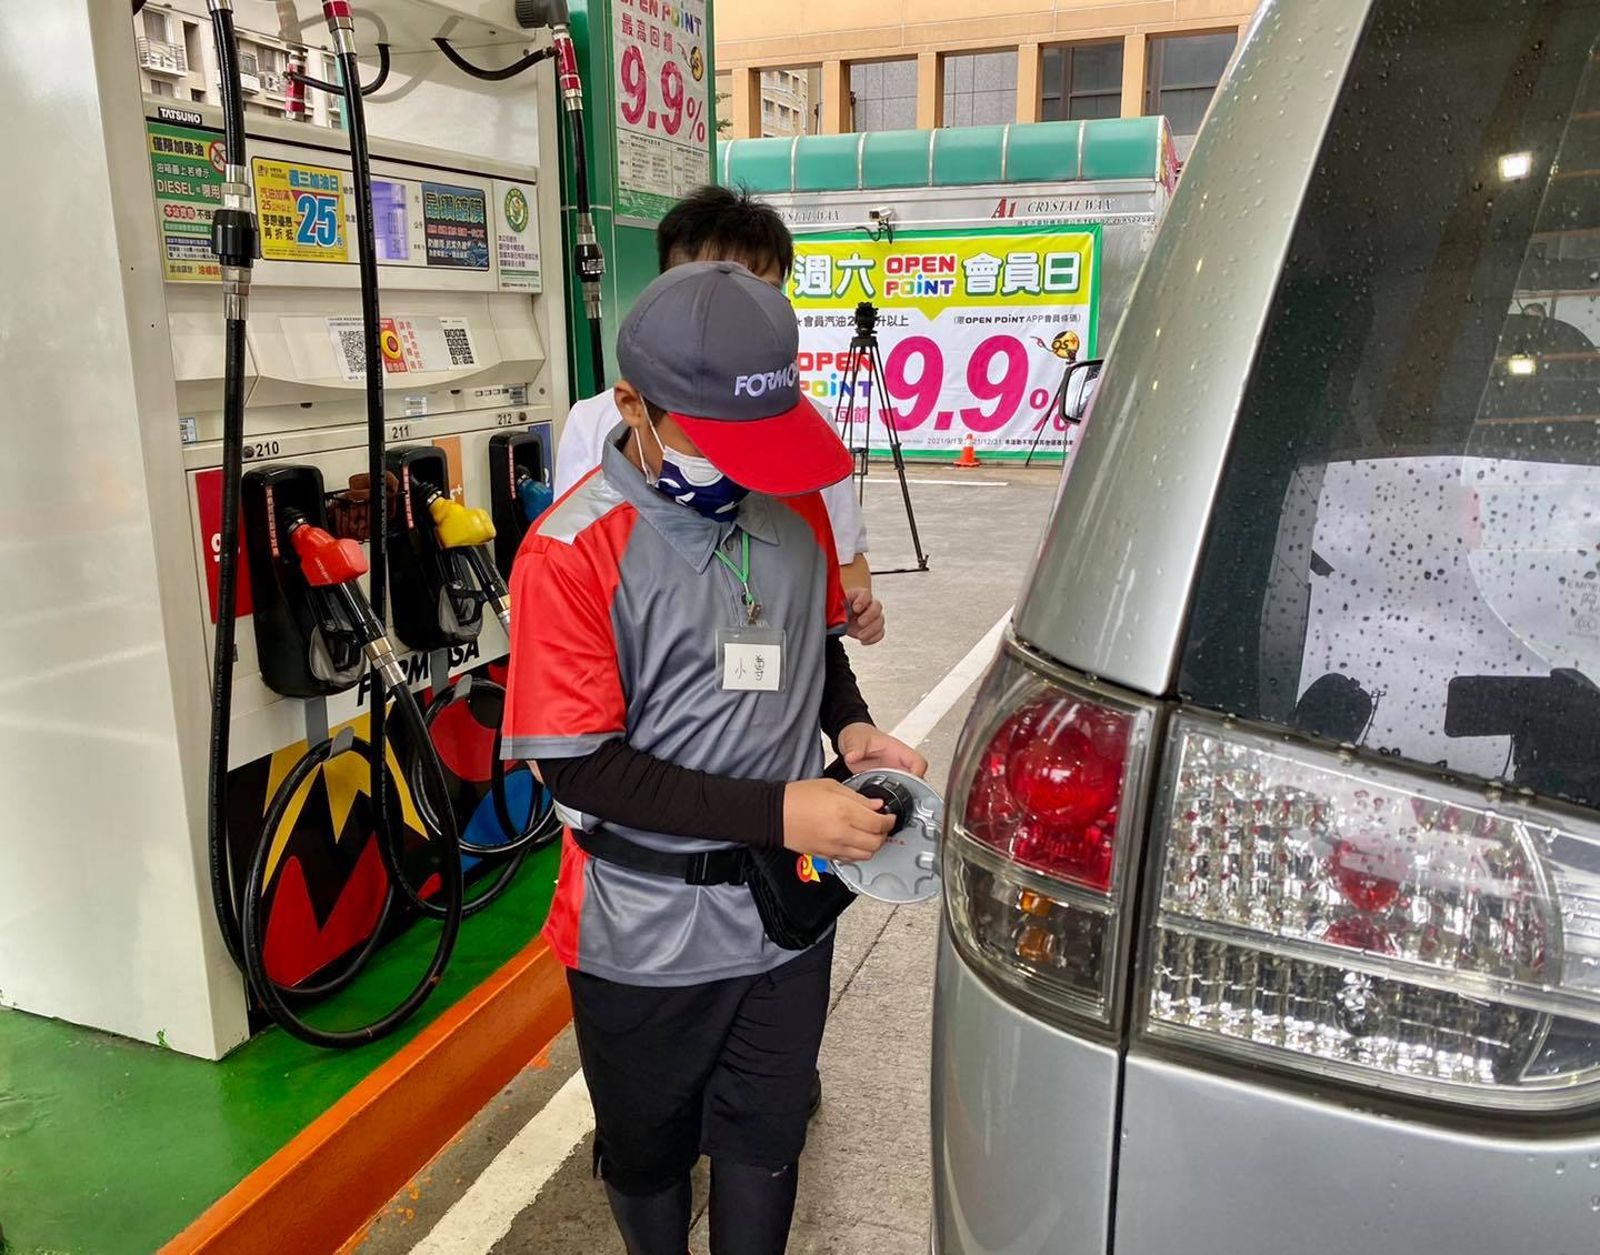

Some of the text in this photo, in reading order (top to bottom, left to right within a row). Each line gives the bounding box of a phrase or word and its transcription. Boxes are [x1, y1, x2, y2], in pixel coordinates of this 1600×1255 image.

[160, 108, 201, 123] TATSUNO
[157, 179, 195, 195] DIESEL
[1027, 200, 1080, 213] CRYSTAL
[297, 194, 337, 245] 25
[886, 256, 956, 273] OPEN
[793, 253, 876, 297] 週六
[963, 252, 1081, 295] 會員日
[798, 352, 873, 371] OPEN
[496, 412, 513, 426] 212
[393, 425, 410, 439] 211
[256, 441, 279, 458] 210
